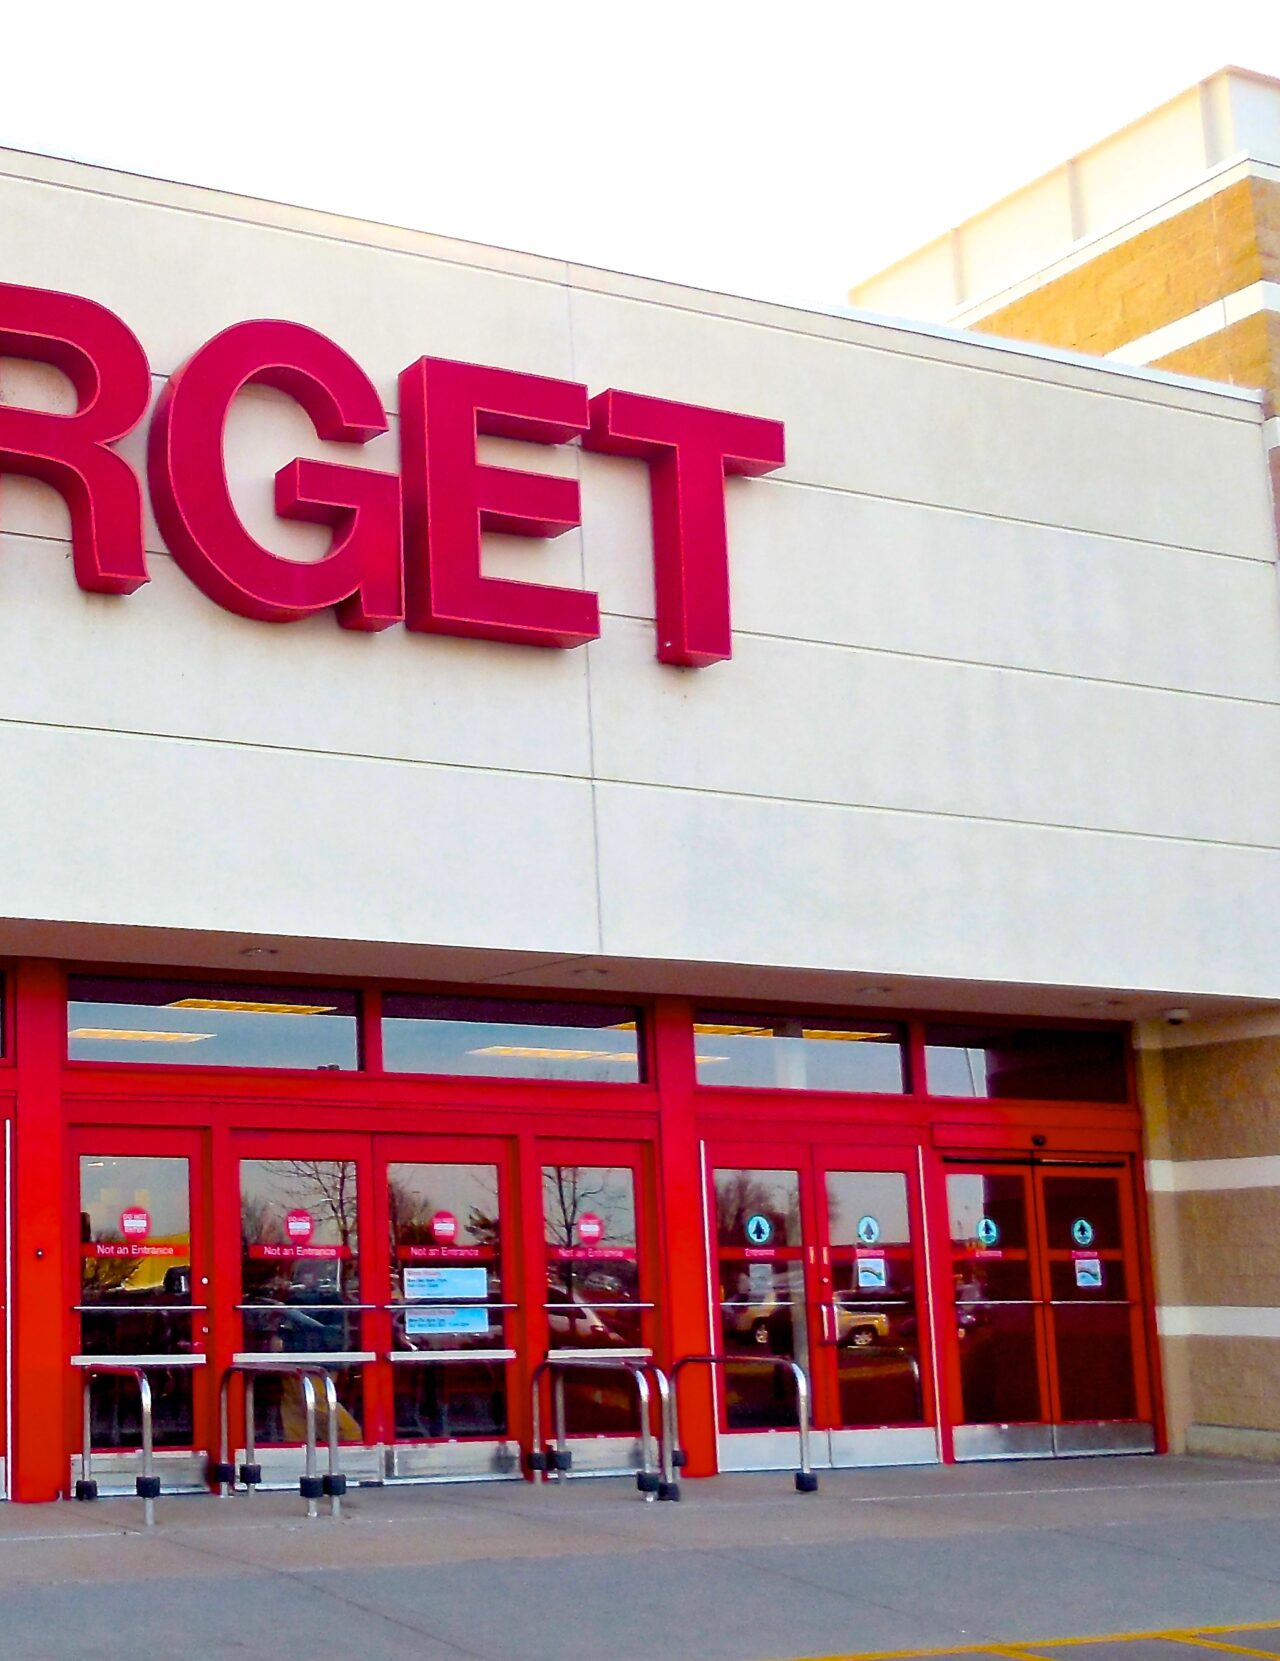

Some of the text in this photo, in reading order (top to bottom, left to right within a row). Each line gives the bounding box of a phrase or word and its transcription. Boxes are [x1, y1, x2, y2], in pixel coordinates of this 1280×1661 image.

[97, 1245, 174, 1255] Not an Entrance
[263, 1246, 337, 1256] Not an Entrance
